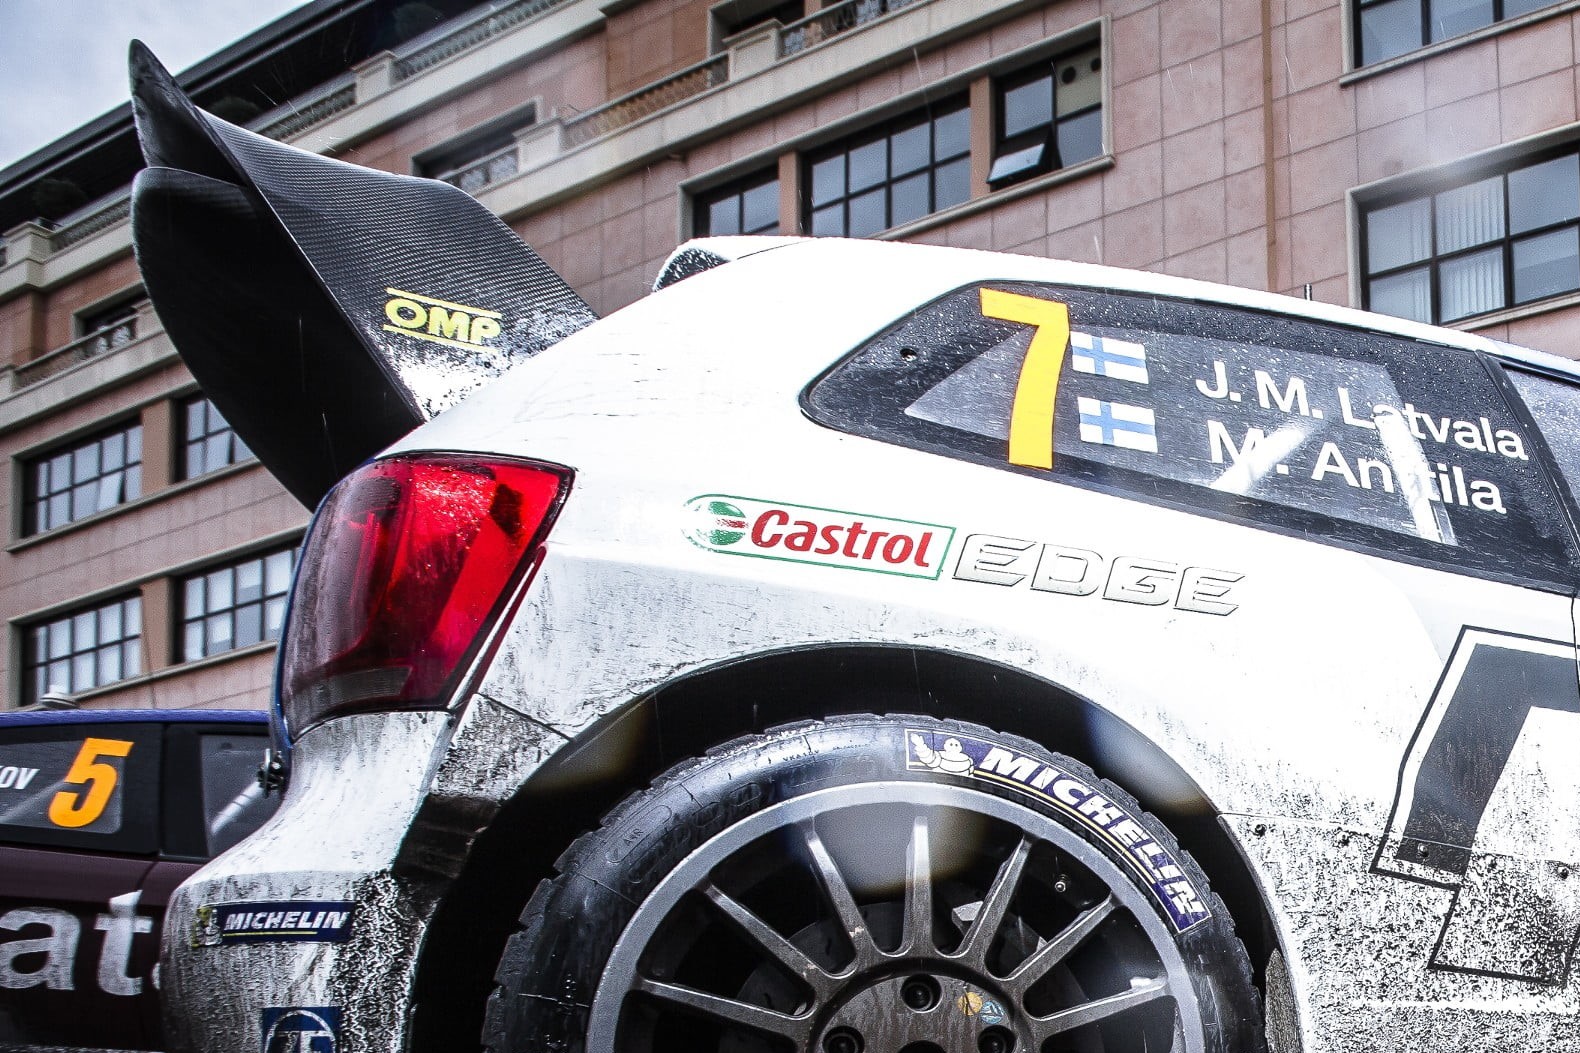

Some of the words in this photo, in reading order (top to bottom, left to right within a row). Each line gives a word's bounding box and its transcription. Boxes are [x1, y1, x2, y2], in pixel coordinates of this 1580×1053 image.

[385, 297, 501, 346] OMP
[979, 287, 1070, 470] 7
[1195, 361, 1242, 402] J.
[1255, 375, 1324, 418] M.
[750, 509, 933, 568] Castrol
[952, 532, 1247, 616] EDGE
[48, 737, 134, 828] 5
[978, 747, 1205, 916] MICHELIN
[0, 890, 161, 996] at
[223, 911, 350, 931] MICHELIN
